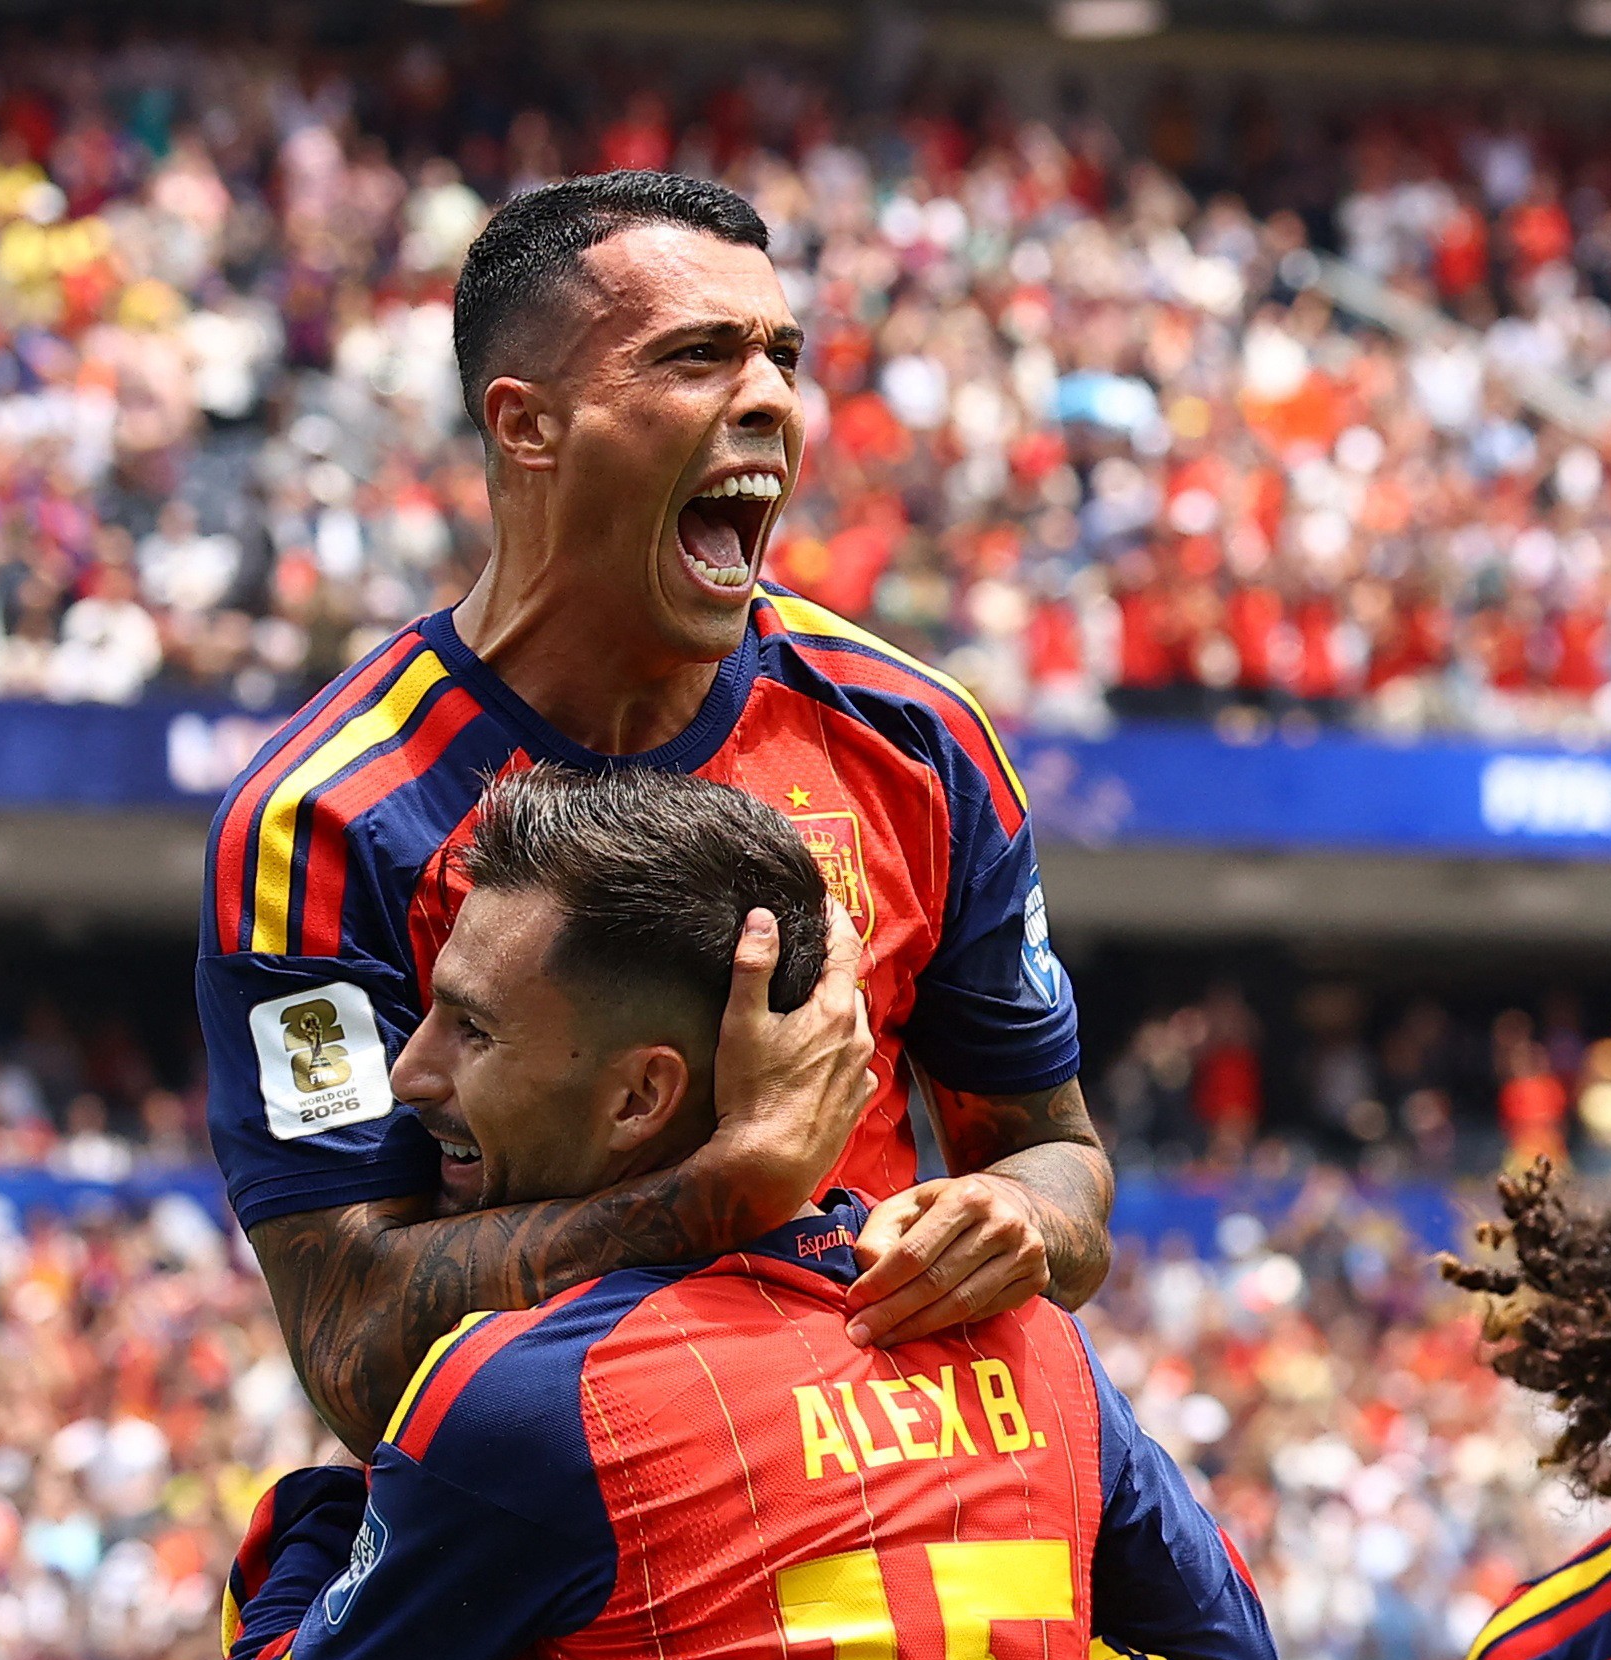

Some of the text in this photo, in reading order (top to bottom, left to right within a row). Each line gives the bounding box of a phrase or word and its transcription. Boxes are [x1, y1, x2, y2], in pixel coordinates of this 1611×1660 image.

[298, 1086, 357, 1108] WORLD CUP
[300, 1097, 361, 1123] 2026
[792, 1358, 1048, 1480] ALEX B.
